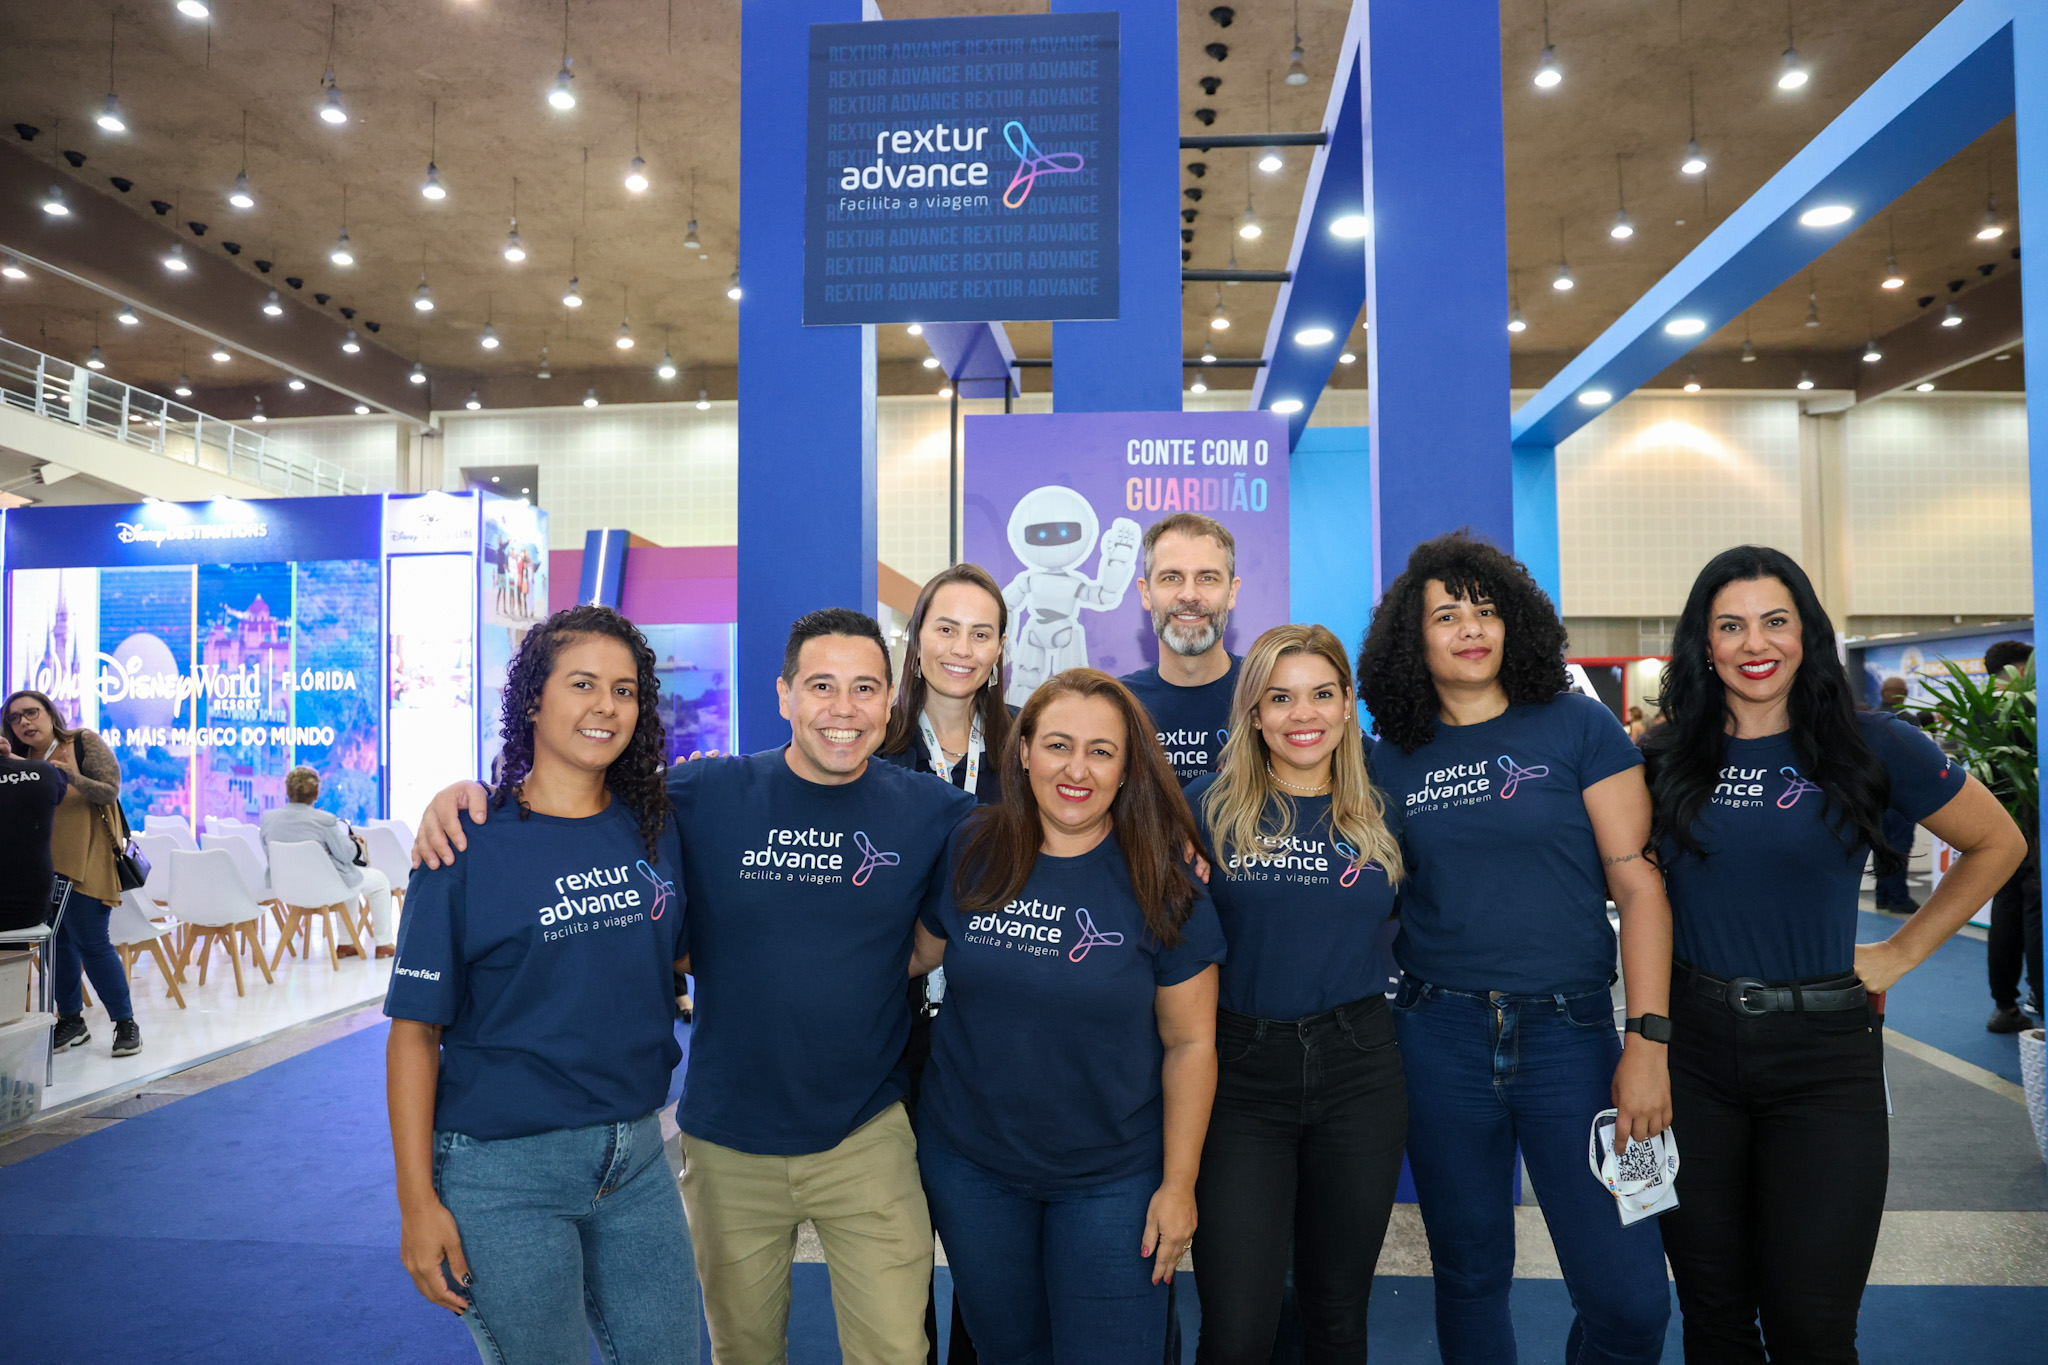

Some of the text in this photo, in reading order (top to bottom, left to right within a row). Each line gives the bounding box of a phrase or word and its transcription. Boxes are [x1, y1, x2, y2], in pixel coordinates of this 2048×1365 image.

[828, 60, 1099, 88] REXTUR ADVANCE REXTUR ADVANCE
[828, 87, 1099, 114] REXTUR ADVANCE REXTUR ADVANCE
[1028, 113, 1099, 133] ADVANCE
[877, 123, 989, 155] rextur
[840, 157, 989, 190] advance
[839, 194, 989, 211] facilita a viagem
[825, 223, 1099, 249] REXTUR ADVANCE REXTUR ADVANCE
[825, 250, 1099, 276] REXTUR ADVANCE REXTUR ADVANCE
[825, 277, 1099, 303] REXTUR ADVANCE REXTUR ADVANCE
[1127, 440, 1269, 465] CONTE COM O
[1126, 472, 1268, 512] GUARDIÃO
[191, 662, 262, 699] World
[281, 667, 357, 692] FLÓRIDA
[213, 699, 261, 711] RESORT
[126, 728, 167, 747] MAIS
[241, 727, 267, 747] DO
[270, 726, 335, 747] MUNDO
[1155, 728, 1209, 746] extur
[1163, 750, 1208, 765] ance
[1425, 760, 1489, 785] rextur
[1405, 778, 1490, 807] advance
[1711, 797, 1764, 809] viagem
[1406, 793, 1492, 818] facilita a viagem
[768, 827, 844, 848] rextur
[741, 846, 844, 870] advance
[554, 864, 629, 895] rextur
[739, 868, 843, 885] facilita a viagem
[1273, 873, 1281, 882] a
[1286, 872, 1329, 886] viagem
[538, 889, 641, 926] advance
[1003, 899, 1066, 922] extur
[543, 910, 644, 943] facilita a viagem
[968, 912, 1062, 944] advance
[964, 932, 1060, 957] facilita a viagem
